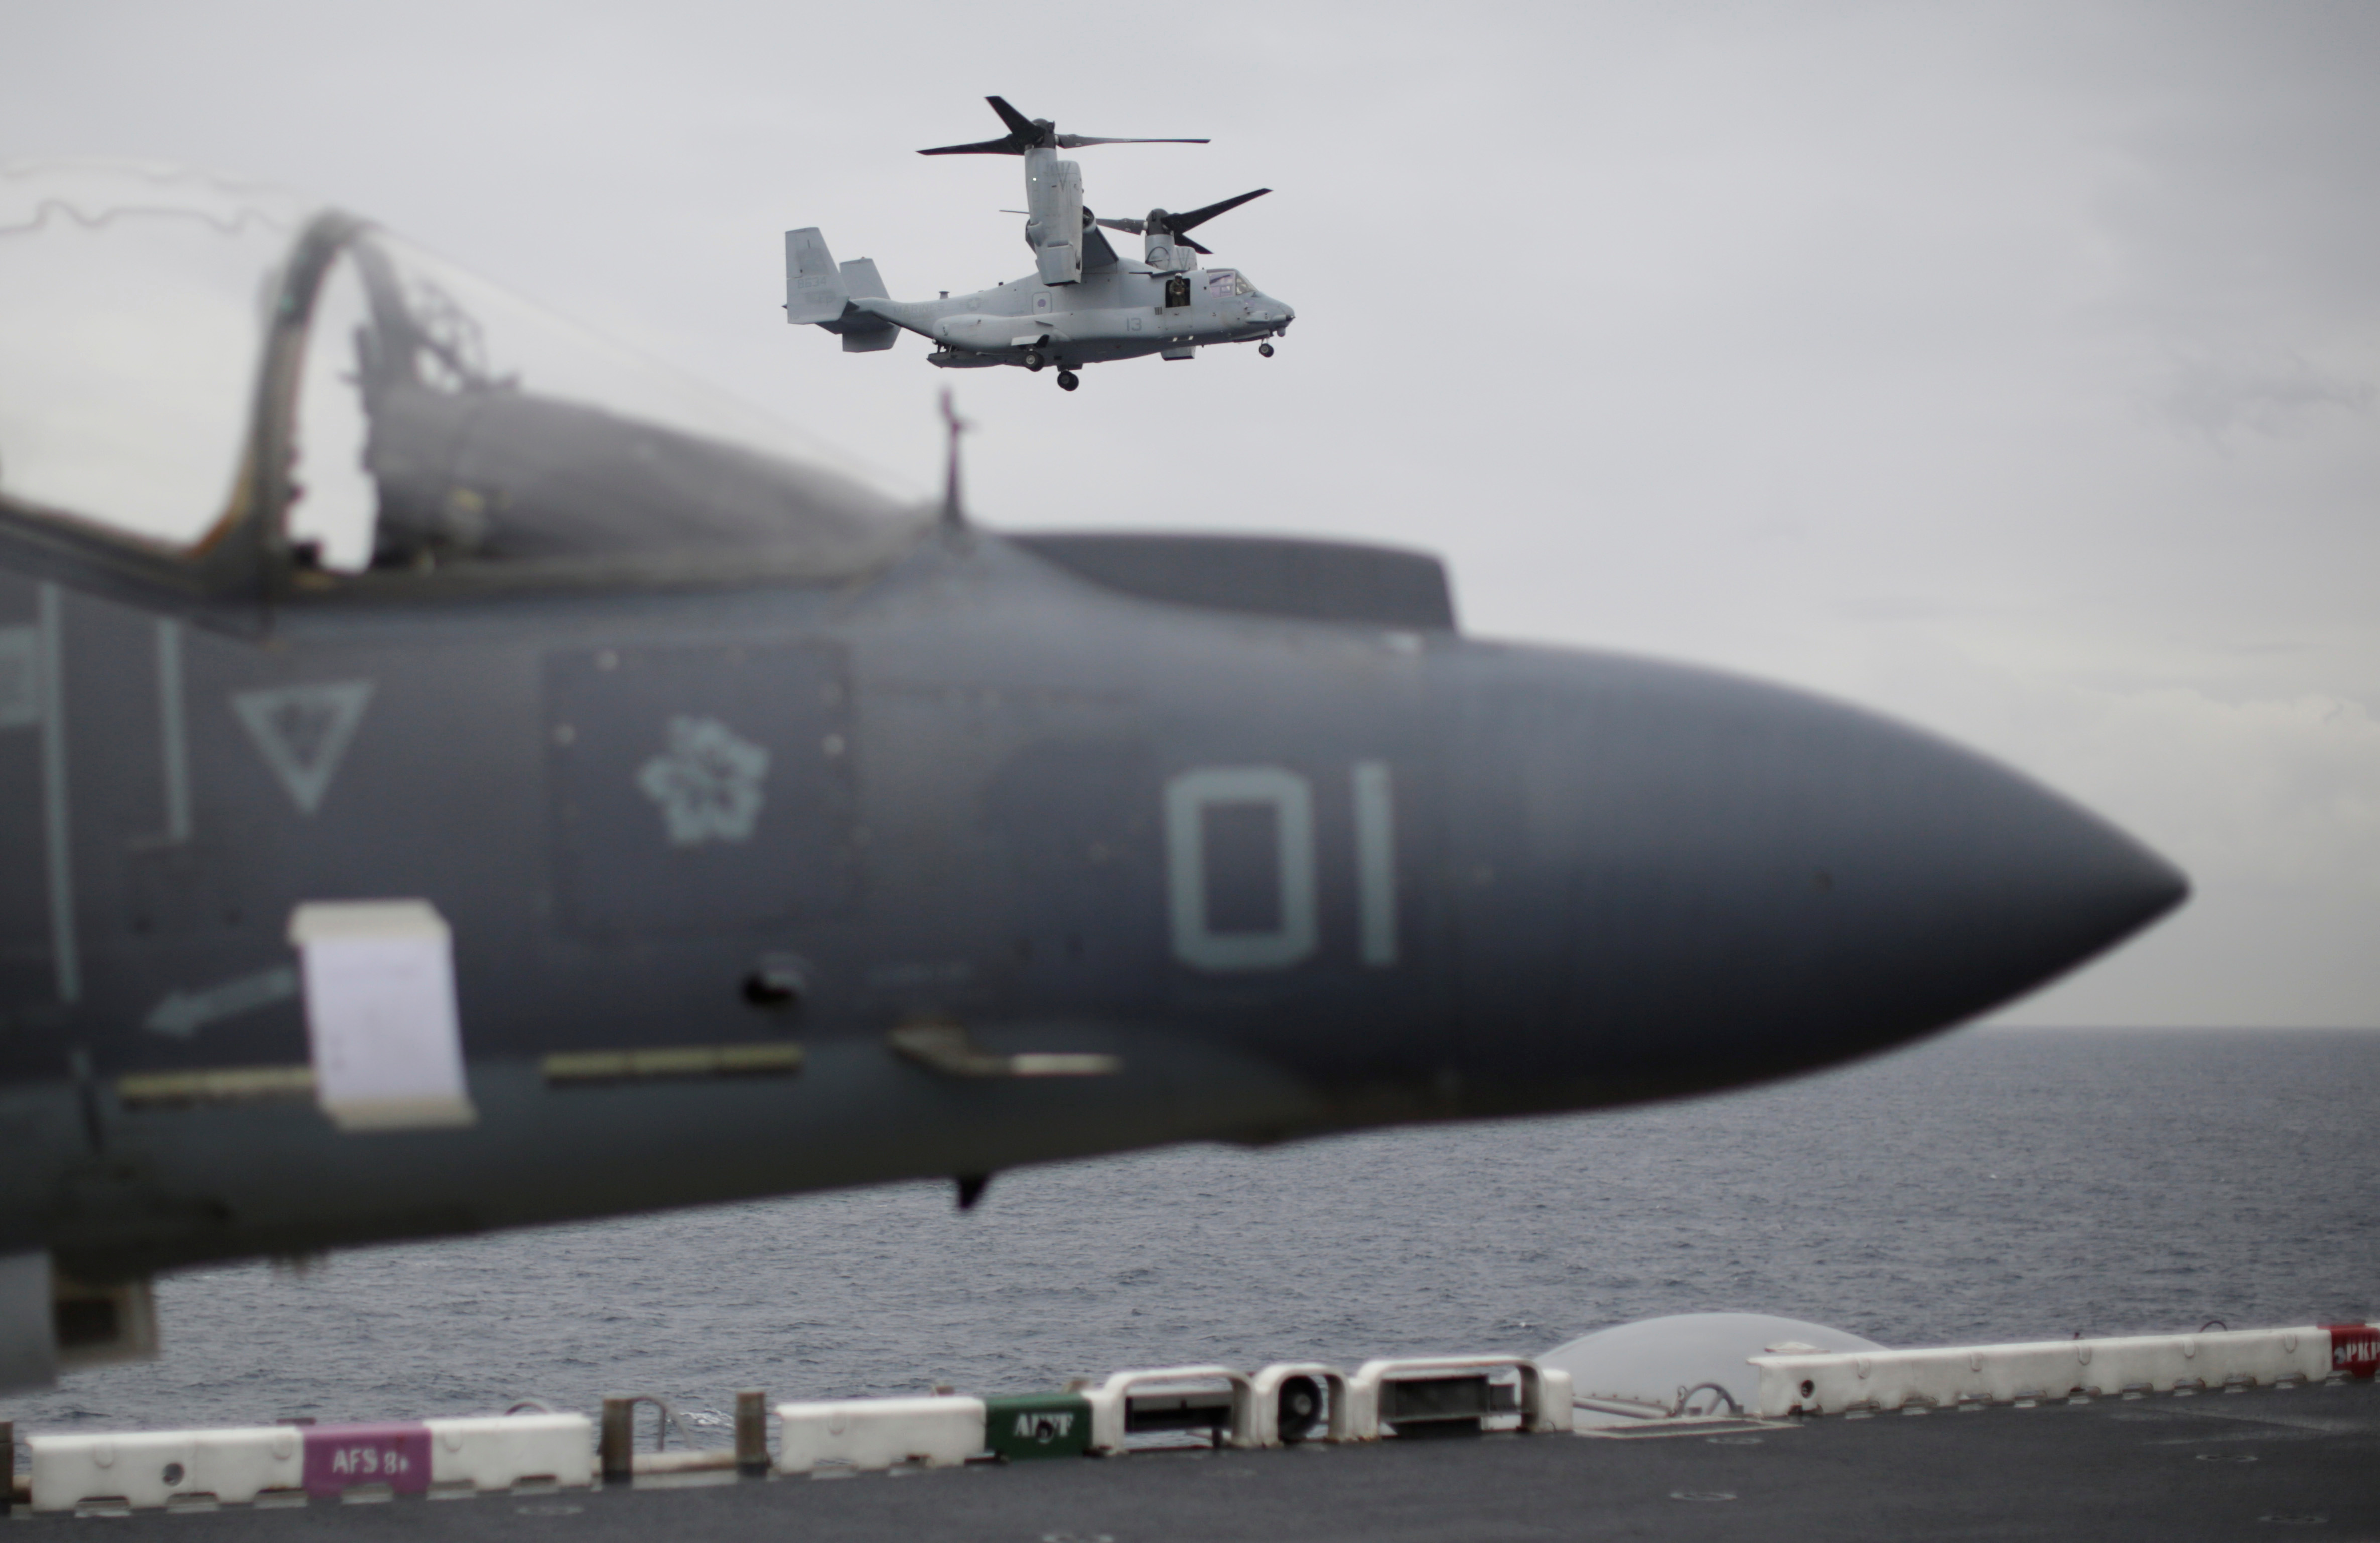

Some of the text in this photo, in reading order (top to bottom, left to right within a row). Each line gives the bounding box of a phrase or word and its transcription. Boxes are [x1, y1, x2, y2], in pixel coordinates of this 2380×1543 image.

[798, 276, 827, 289] 8634
[893, 303, 945, 315] MARINES
[1126, 317, 1142, 331] 13
[1166, 761, 1397, 971] 01
[333, 1448, 377, 1474] AFS
